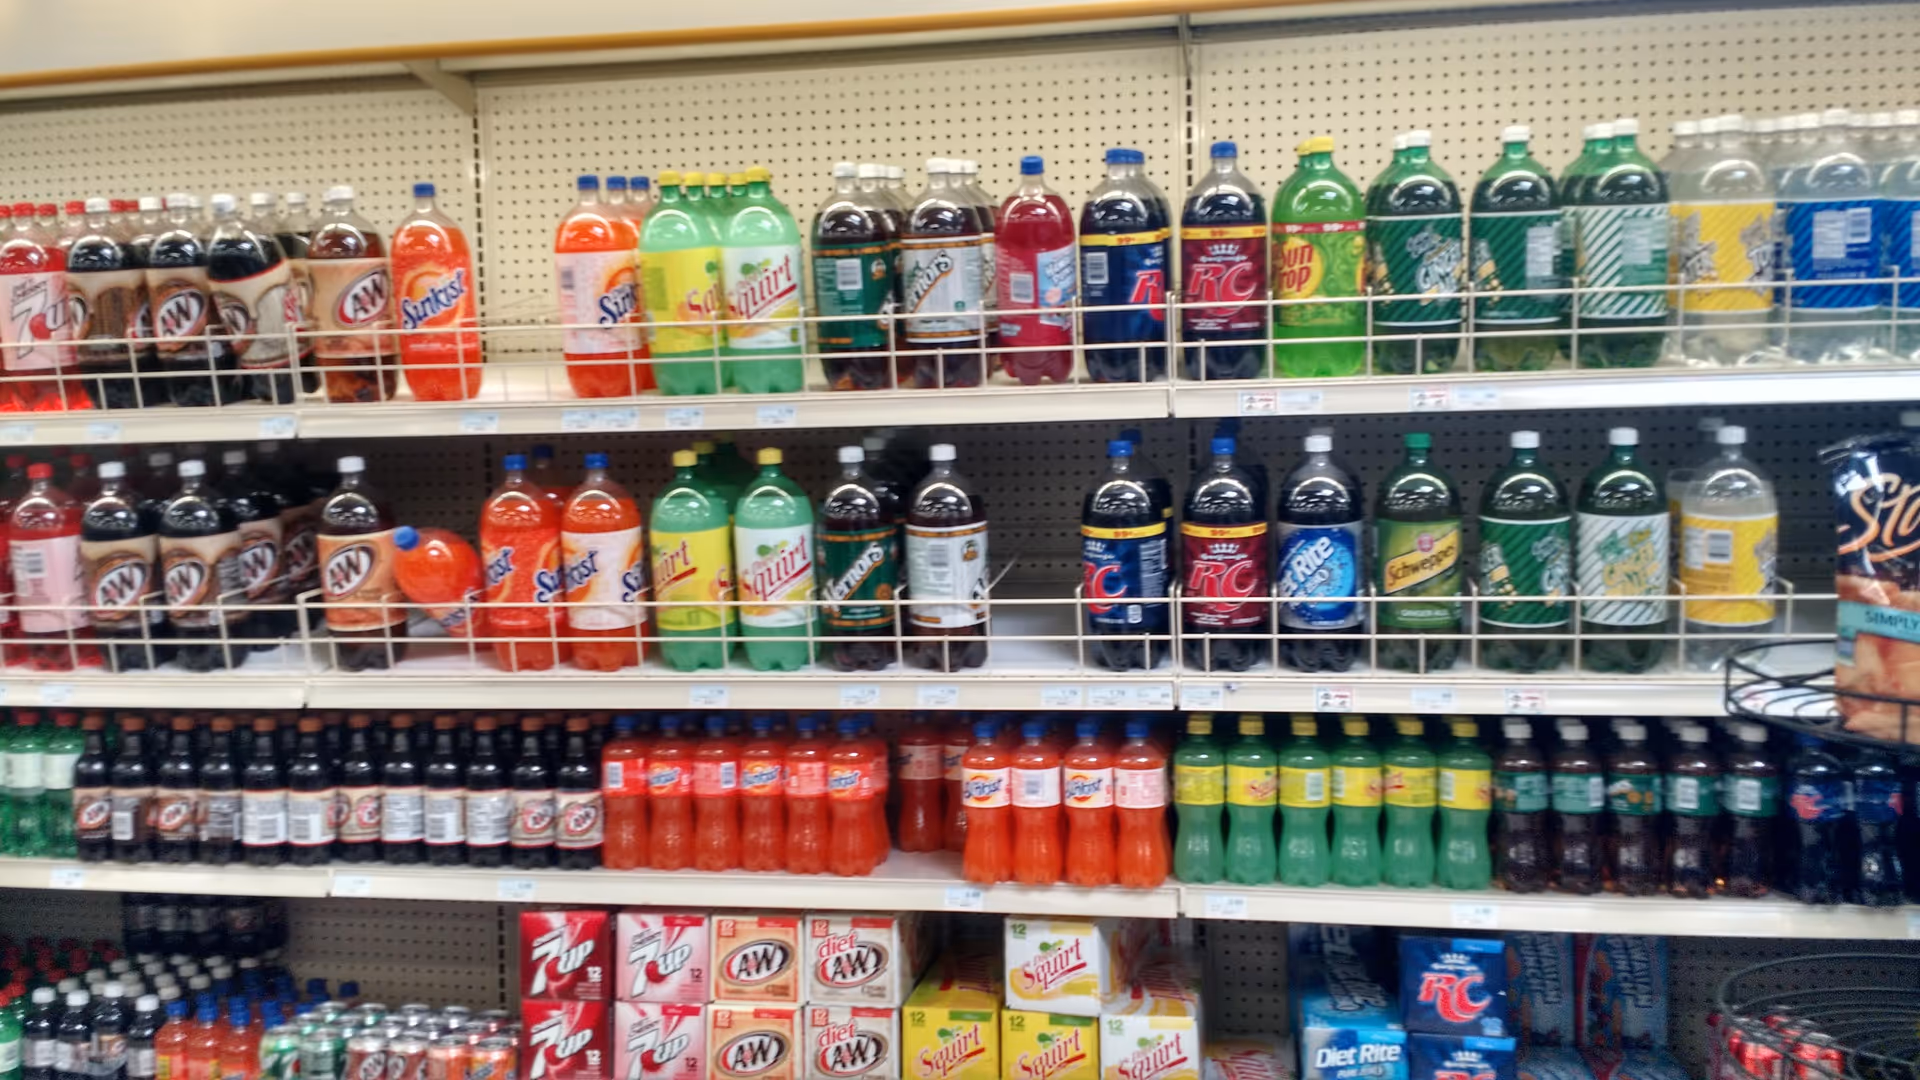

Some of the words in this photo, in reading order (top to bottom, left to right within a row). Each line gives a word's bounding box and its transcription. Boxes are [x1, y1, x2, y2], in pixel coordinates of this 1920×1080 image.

[351, 276, 385, 322] A&W
[402, 268, 465, 330] Sunkist
[1130, 269, 1165, 321] R
[1189, 262, 1257, 317] RC
[1837, 472, 1920, 553] Sta
[329, 549, 361, 591] A&W
[1189, 559, 1258, 613] RC
[1864, 609, 1920, 631] SIMPLY
[818, 929, 856, 959] diet
[1010, 923, 1027, 935] 12
[530, 934, 594, 996] 7UP
[628, 938, 692, 998] 7UP
[736, 946, 777, 980] A&W
[831, 947, 871, 982] A&W
[1021, 938, 1082, 991] Squirt
[909, 1011, 925, 1023] 12
[1417, 972, 1493, 1023] RC
[818, 1019, 856, 1048] diet
[1009, 1016, 1025, 1027] 12
[1107, 1019, 1124, 1031] 12
[529, 1022, 593, 1080] 7UP
[627, 1028, 689, 1080] 7UP
[731, 1036, 773, 1072] A&W
[830, 1036, 871, 1072] A&W
[919, 1023, 981, 1077] Squirt
[1018, 1028, 1081, 1080] Squirt
[1316, 1048, 1356, 1068] Diet
[1359, 1044, 1401, 1064] Rite
